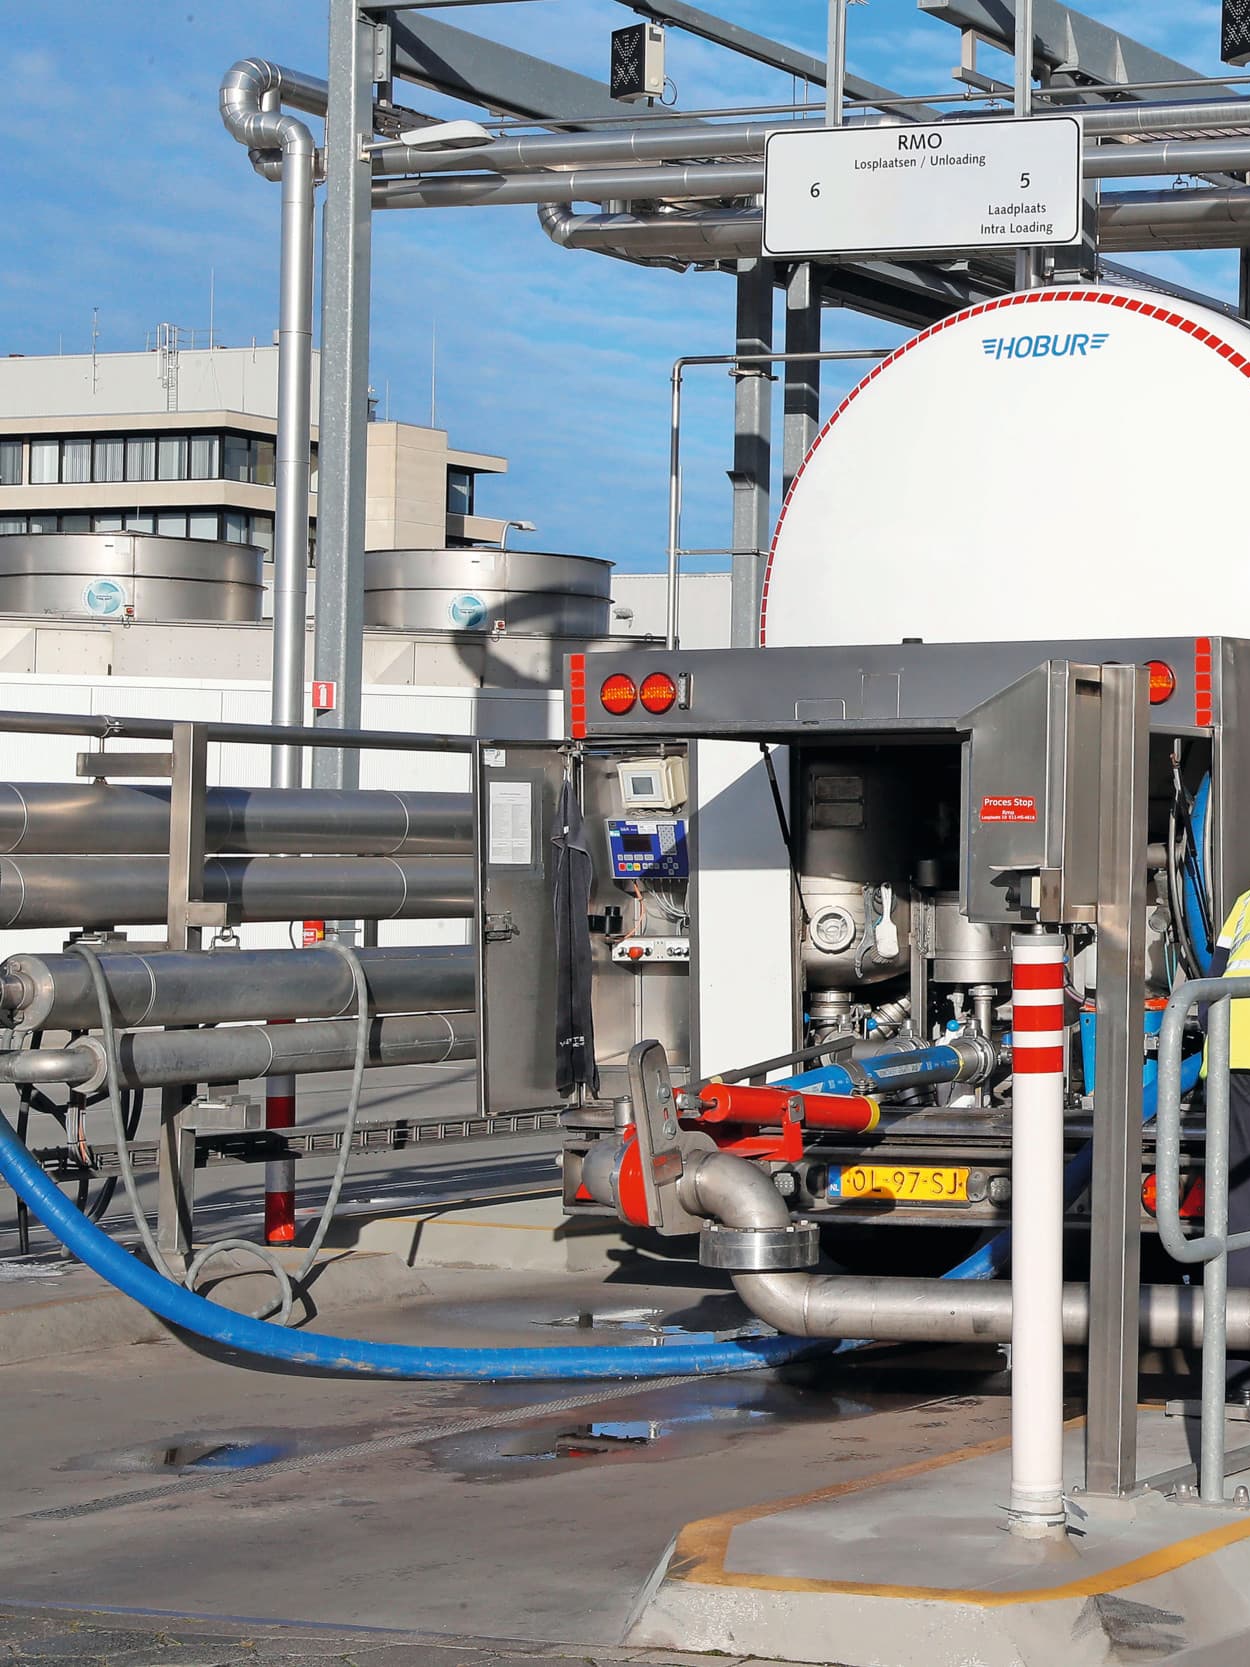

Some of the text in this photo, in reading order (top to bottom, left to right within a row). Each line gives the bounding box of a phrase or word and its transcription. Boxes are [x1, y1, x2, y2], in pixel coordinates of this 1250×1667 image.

[897, 132, 943, 151] RMO
[854, 153, 987, 172] Losplaatsen / Unloading
[809, 181, 822, 199] 6
[1019, 172, 1032, 190] 5
[988, 202, 1047, 217] Laadplaats
[980, 220, 1054, 236] Intra Loading
[995, 333, 1090, 360] HOBUR
[984, 798, 1033, 808] Proces Stop
[853, 1169, 958, 1195] OL-97-SJ
